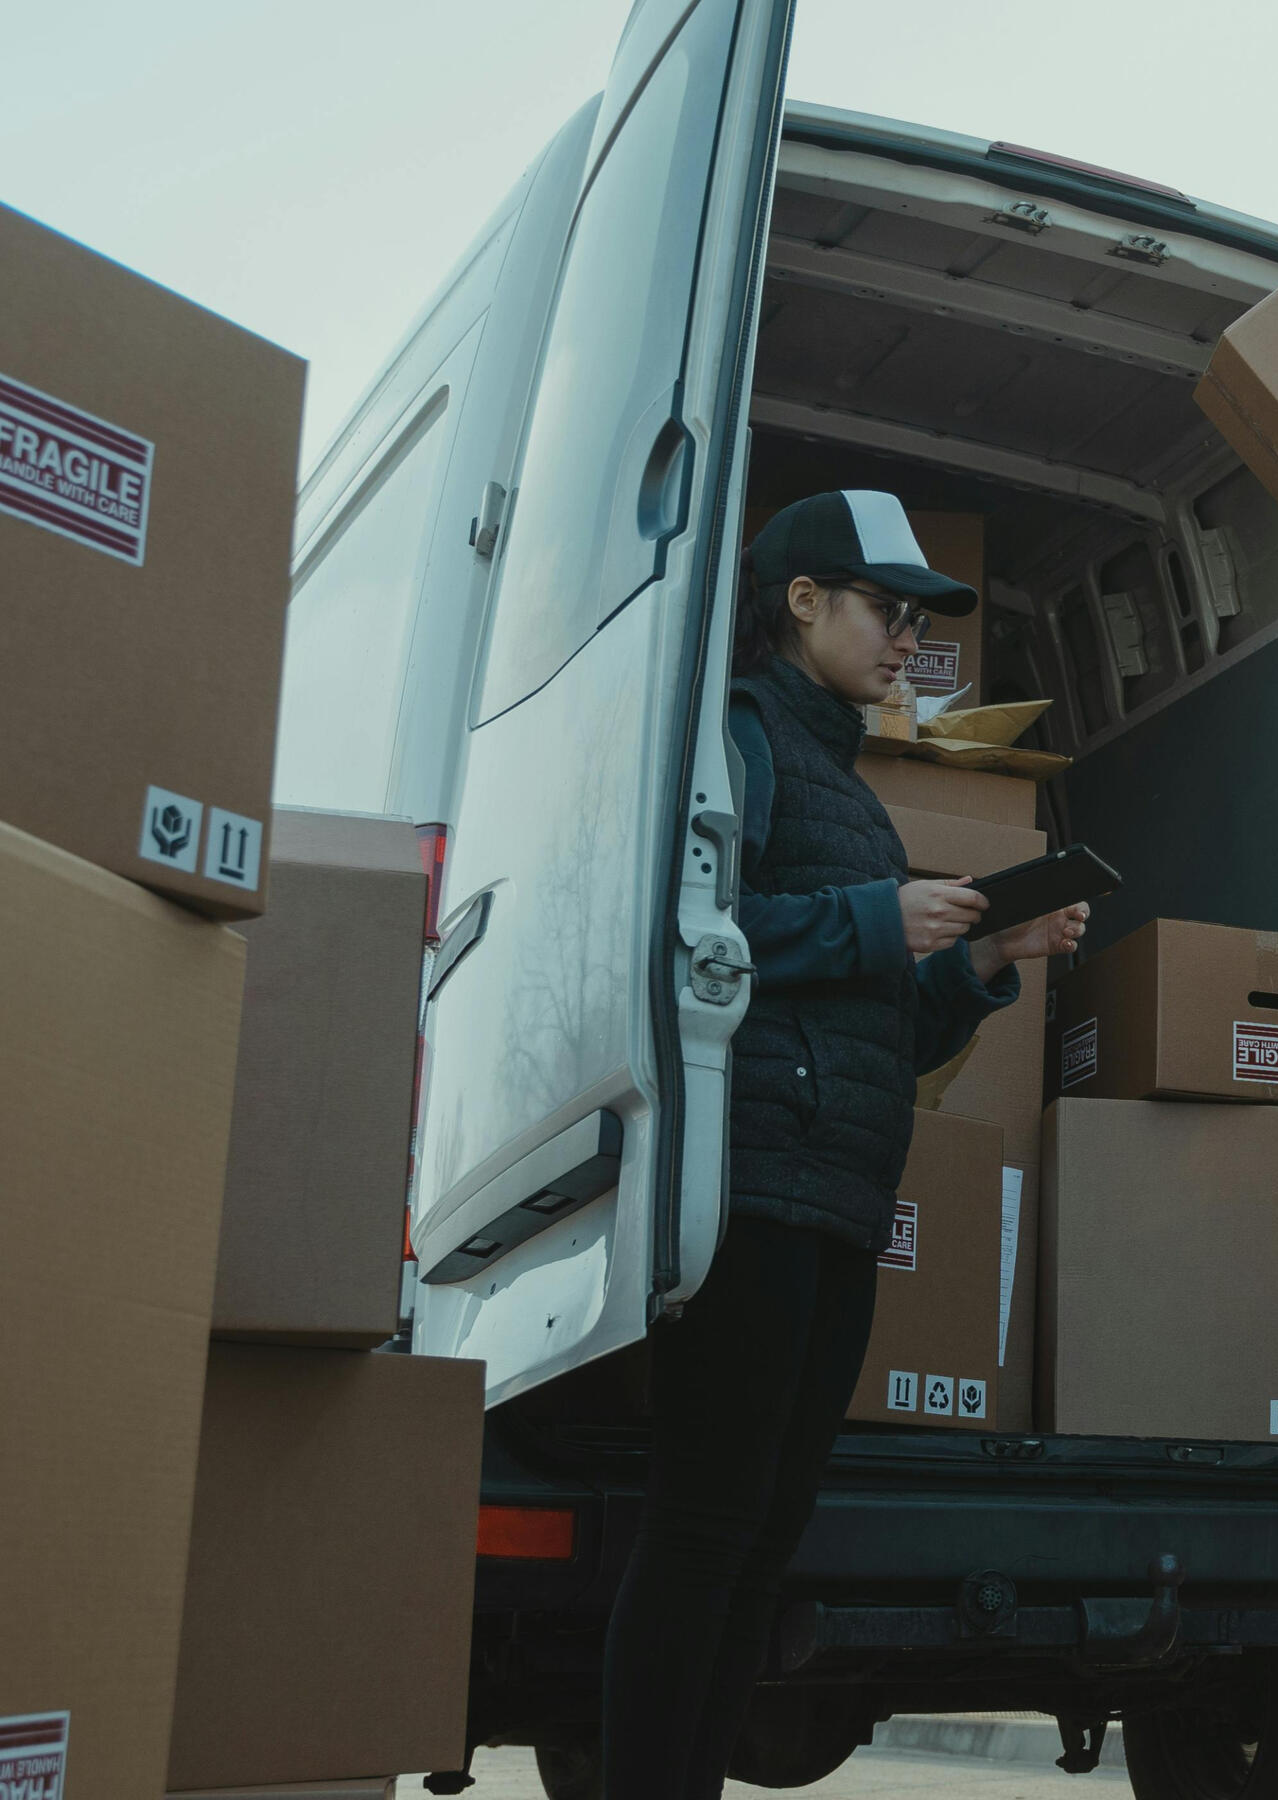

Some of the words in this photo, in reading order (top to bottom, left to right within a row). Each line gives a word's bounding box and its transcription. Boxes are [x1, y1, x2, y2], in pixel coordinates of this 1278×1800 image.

[57, 478, 96, 507] WITH
[98, 497, 138, 525] CARE
[905, 655, 954, 670] AGILE
[914, 667, 932, 675] WITH
[933, 668, 953, 677] CARE
[1238, 1039, 1260, 1048] CARE
[1064, 1041, 1096, 1070] FRAGILE
[892, 1240, 912, 1250] CARE
[18, 1756, 61, 1777] HANDLE
